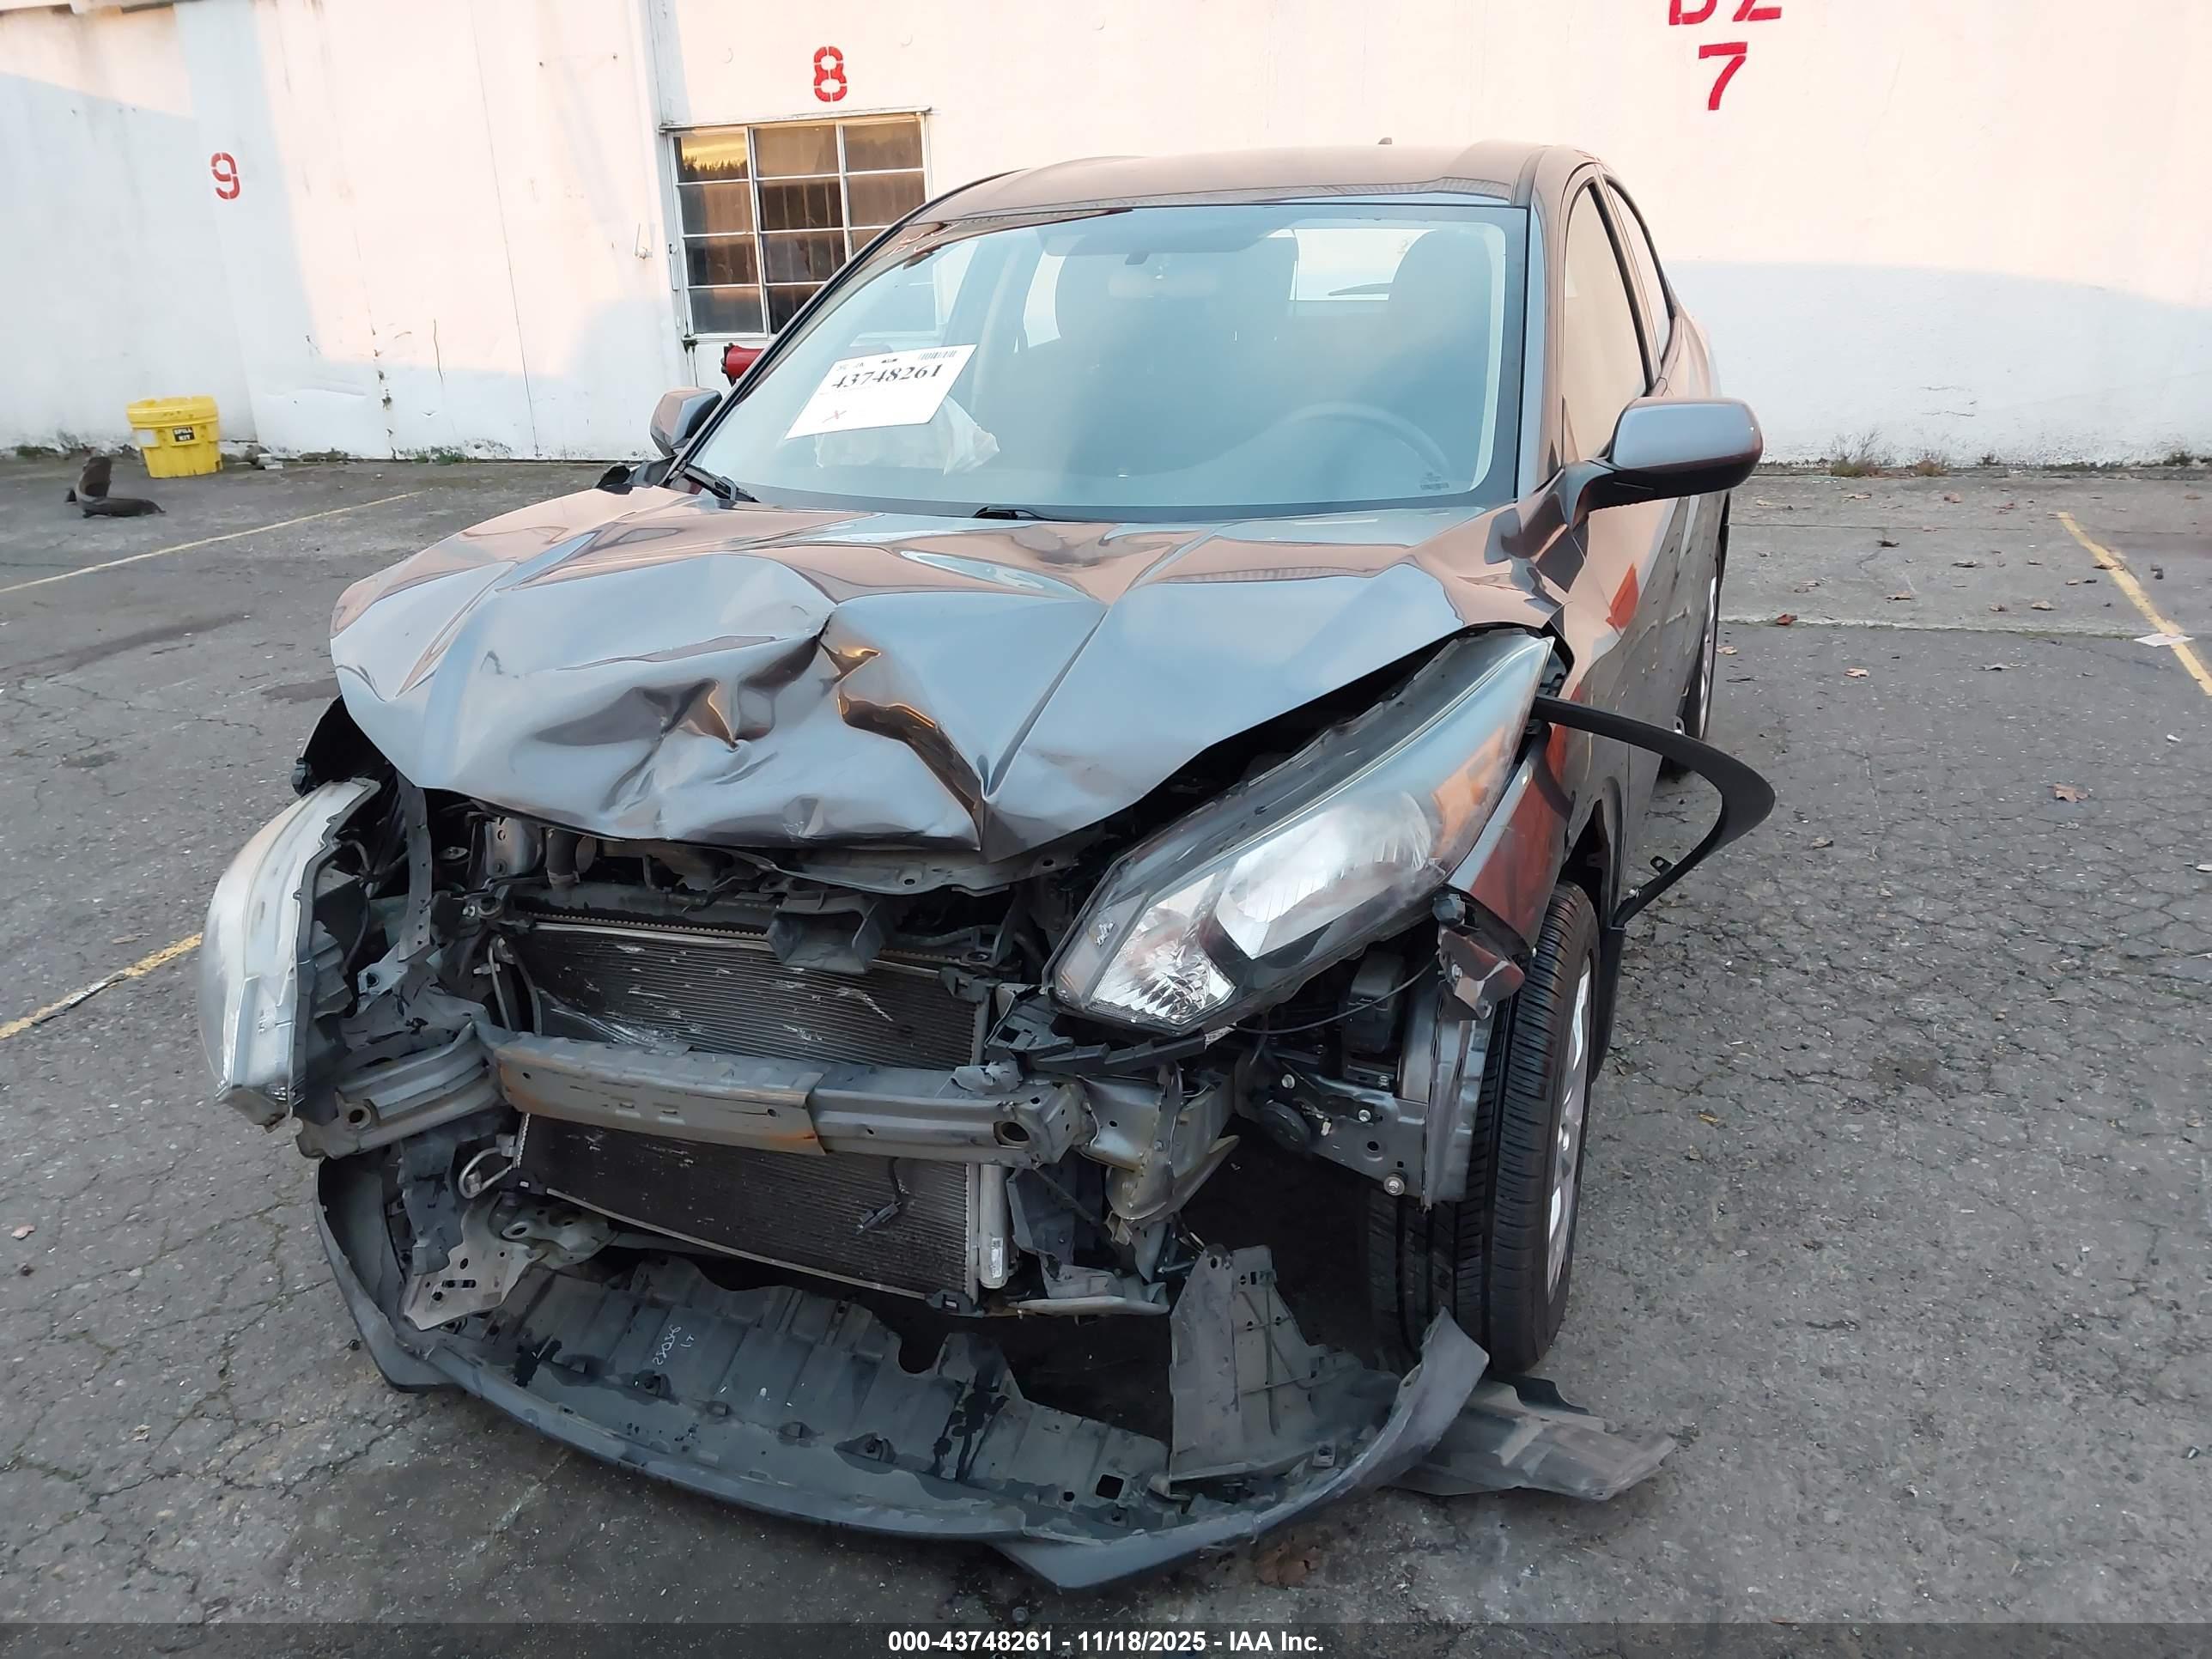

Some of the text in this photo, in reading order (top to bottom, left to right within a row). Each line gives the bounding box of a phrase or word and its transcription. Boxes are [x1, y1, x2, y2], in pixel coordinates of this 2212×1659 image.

[813, 46, 848, 102] 8
[1698, 41, 1748, 111] 7
[210, 152, 240, 200] 9
[831, 363, 943, 389] 43748261
